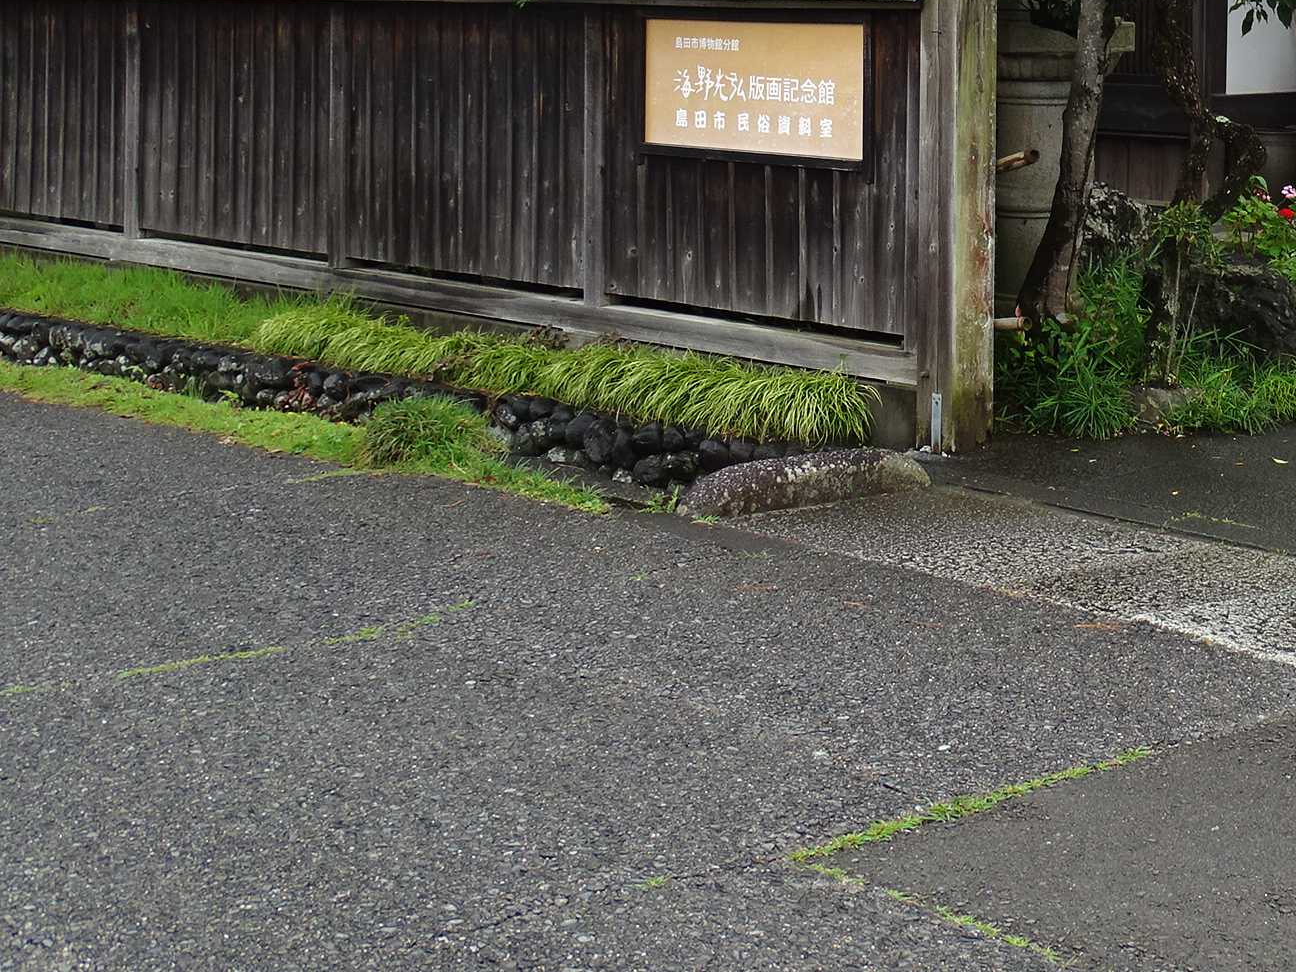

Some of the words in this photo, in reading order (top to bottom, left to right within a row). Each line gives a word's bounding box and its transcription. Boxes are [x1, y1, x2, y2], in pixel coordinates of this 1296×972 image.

[674, 36, 740, 52] 島田市博物館分館
